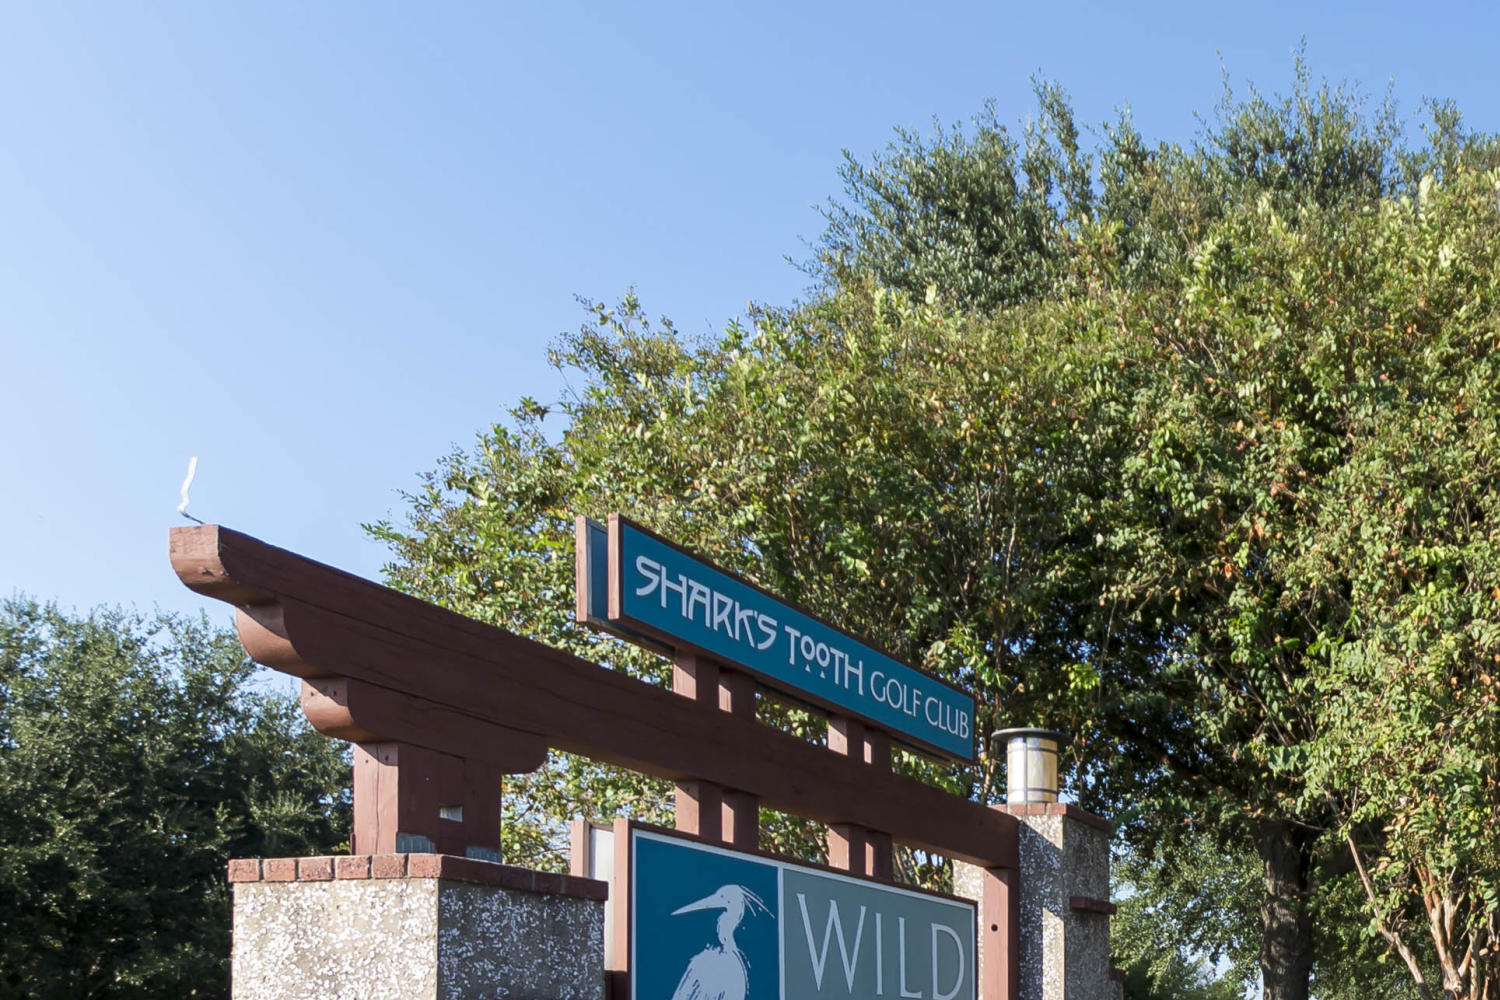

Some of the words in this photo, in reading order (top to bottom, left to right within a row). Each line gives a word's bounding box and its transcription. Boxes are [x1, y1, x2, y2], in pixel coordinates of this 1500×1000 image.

[784, 624, 864, 696] TOOTH
[870, 670, 922, 718] GOLF
[925, 696, 970, 740] CLUB
[796, 893, 965, 1000] WILD
